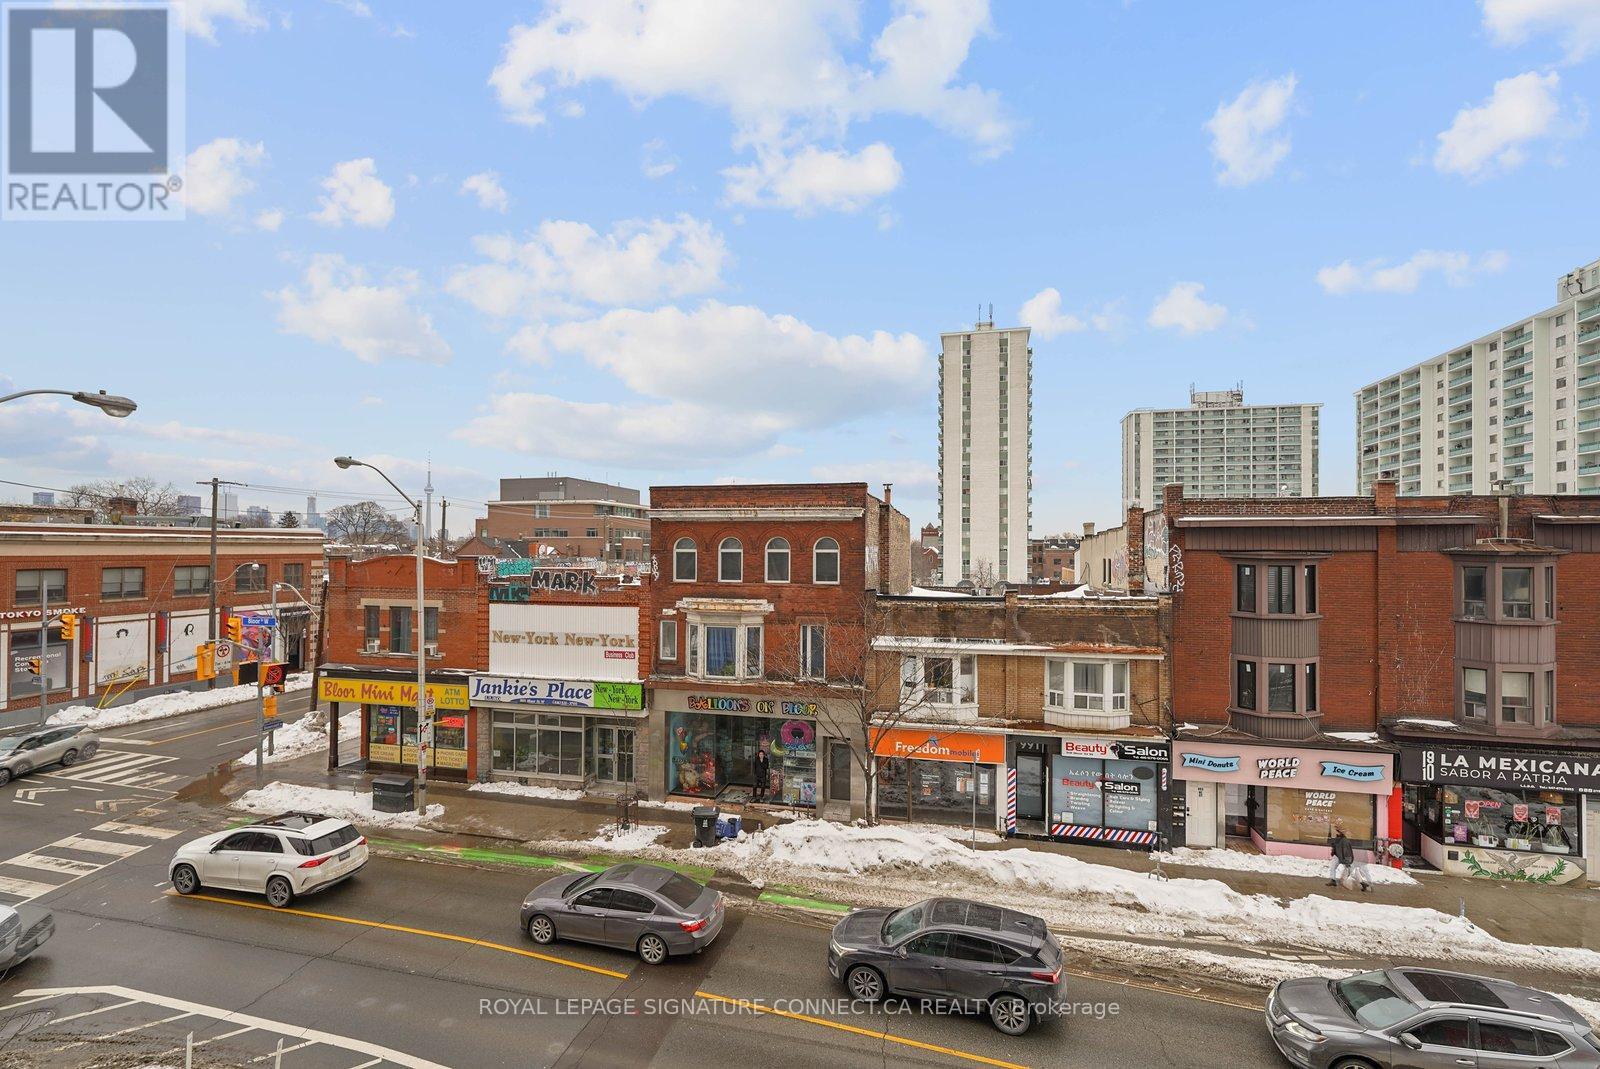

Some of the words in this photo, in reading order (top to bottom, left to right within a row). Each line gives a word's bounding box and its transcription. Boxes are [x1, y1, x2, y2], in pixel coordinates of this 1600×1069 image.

[0, 610, 42, 619] TOKYO
[46, 607, 87, 616] SMOKE
[492, 630, 559, 646] New-York
[564, 633, 635, 648] New-York
[14, 652, 61, 662] Recreaonal
[605, 651, 623, 659] Business
[323, 681, 356, 698] Bloor
[361, 683, 394, 701] Mini
[400, 685, 434, 702] Mat
[444, 687, 461, 696] ATM
[472, 678, 538, 698] Jankie's
[546, 682, 593, 700] Place
[440, 697, 465, 706] LOTTO
[756, 700, 774, 714] ON
[895, 741, 950, 756] Freedom
[1065, 742, 1107, 756] Beauty
[1124, 745, 1168, 757] Salon
[1188, 757, 1206, 765] Mini
[1207, 760, 1234, 768] Donuts
[1257, 757, 1300, 769] WORLD
[1440, 753, 1469, 767] LA
[1259, 768, 1297, 779] PEACE
[1332, 766, 1346, 774] Ice
[1348, 769, 1375, 778] Cream
[1440, 767, 1491, 780] SABOR
[1497, 772, 1507, 781] A
[1513, 773, 1567, 785] PATRIA
[1062, 777, 1095, 789] Beauty
[1104, 781, 1138, 792] Salon
[1305, 792, 1336, 800] WORLD
[1305, 799, 1333, 807] PEACE
[1479, 800, 1501, 809] OPEN
